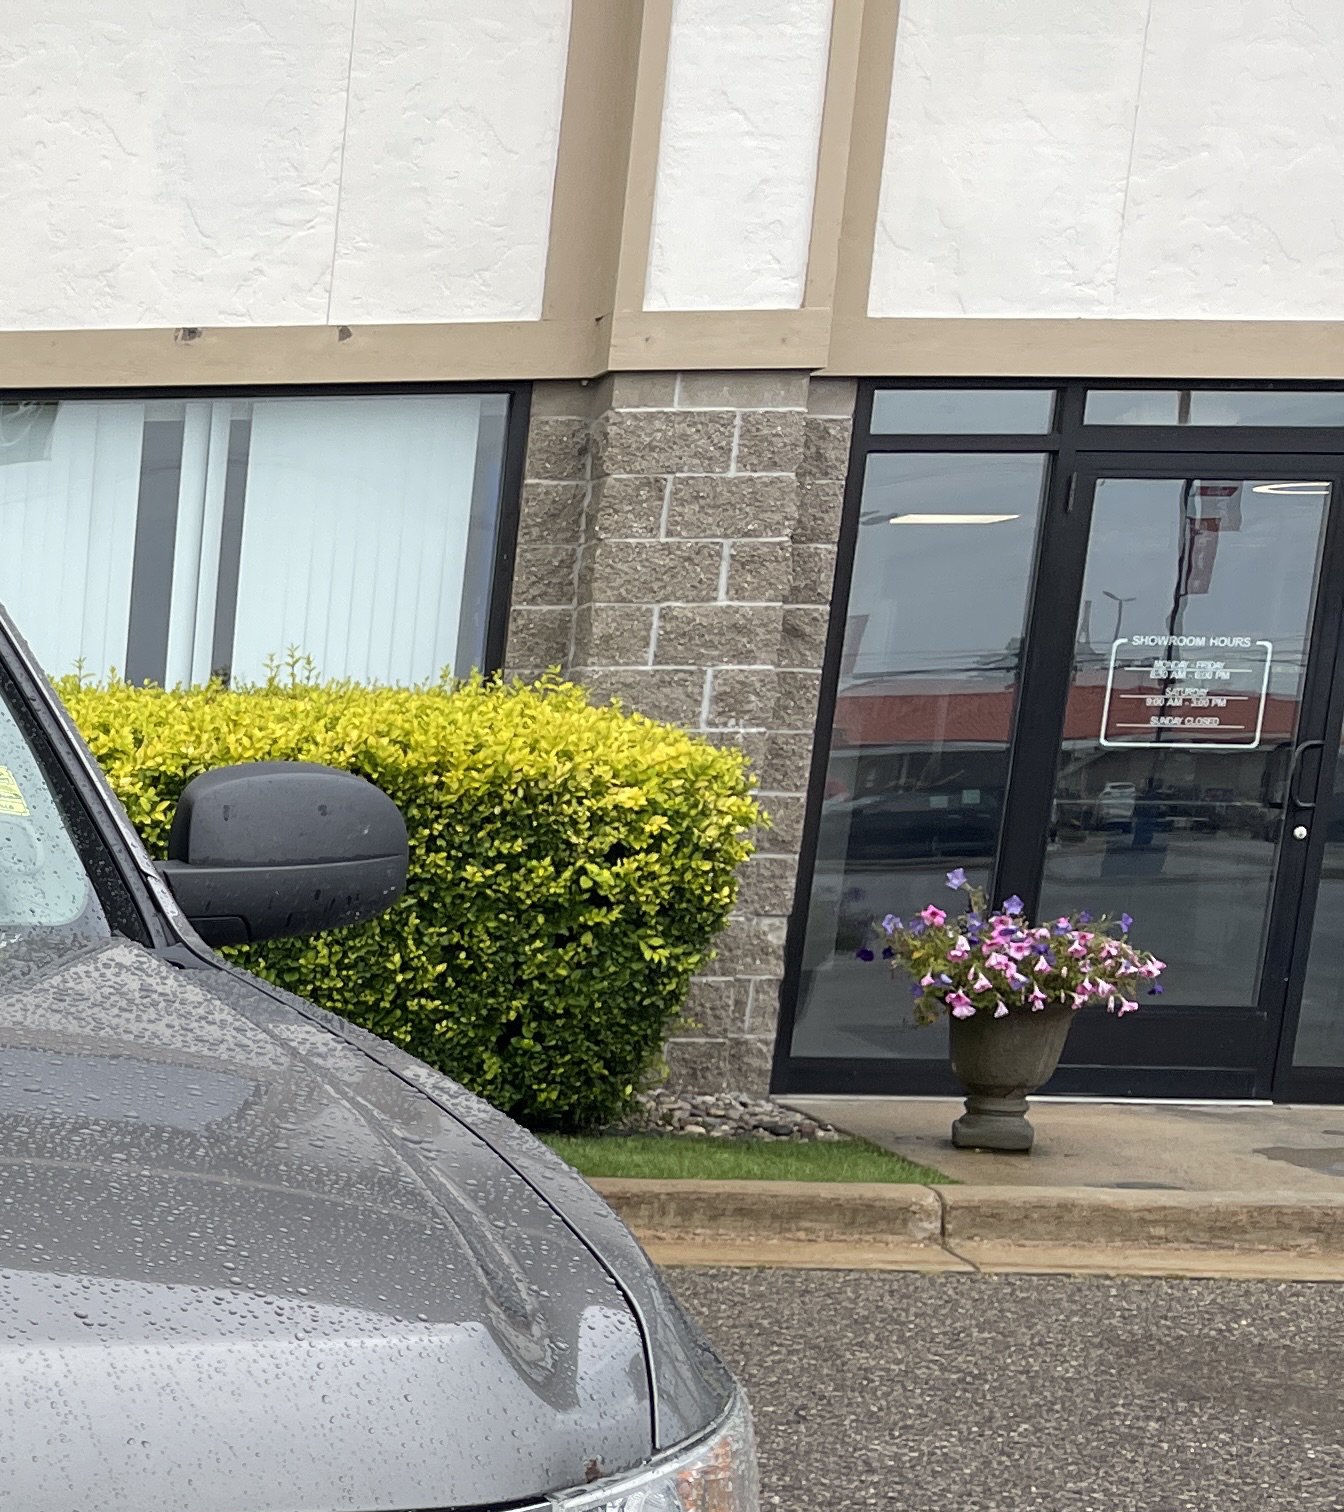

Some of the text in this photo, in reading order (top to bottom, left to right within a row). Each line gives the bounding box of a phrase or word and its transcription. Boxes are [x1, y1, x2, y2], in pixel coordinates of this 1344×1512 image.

[1132, 635, 1251, 648] SHOWROOM HOURS
[1170, 670, 1186, 679] AM
[1215, 671, 1230, 680] PM
[1165, 687, 1209, 697] SATURDAY
[1167, 697, 1183, 707] AM
[1150, 716, 1220, 726] SUNDAY CLOSED
